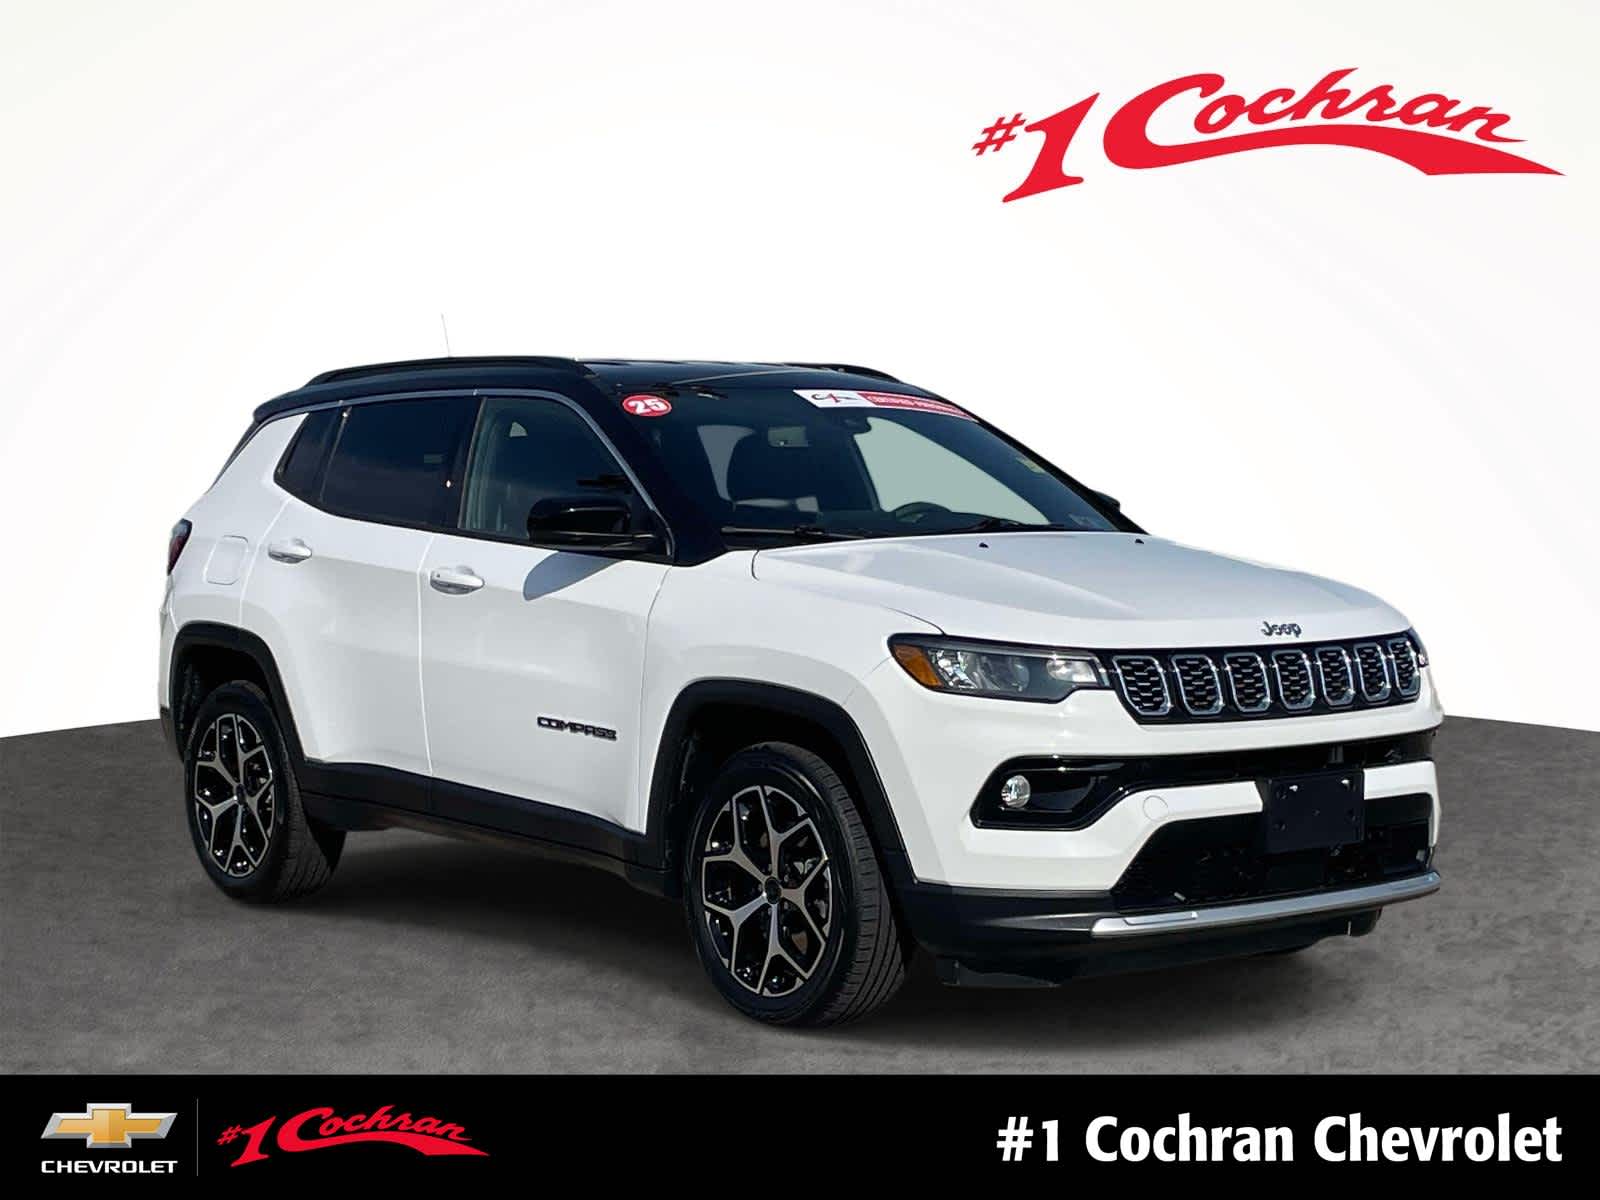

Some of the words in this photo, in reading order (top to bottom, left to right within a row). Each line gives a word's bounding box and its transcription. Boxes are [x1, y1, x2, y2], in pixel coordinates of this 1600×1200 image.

[627, 398, 668, 415] 25
[1261, 620, 1302, 638] Jeep
[537, 716, 617, 741] COMPASS
